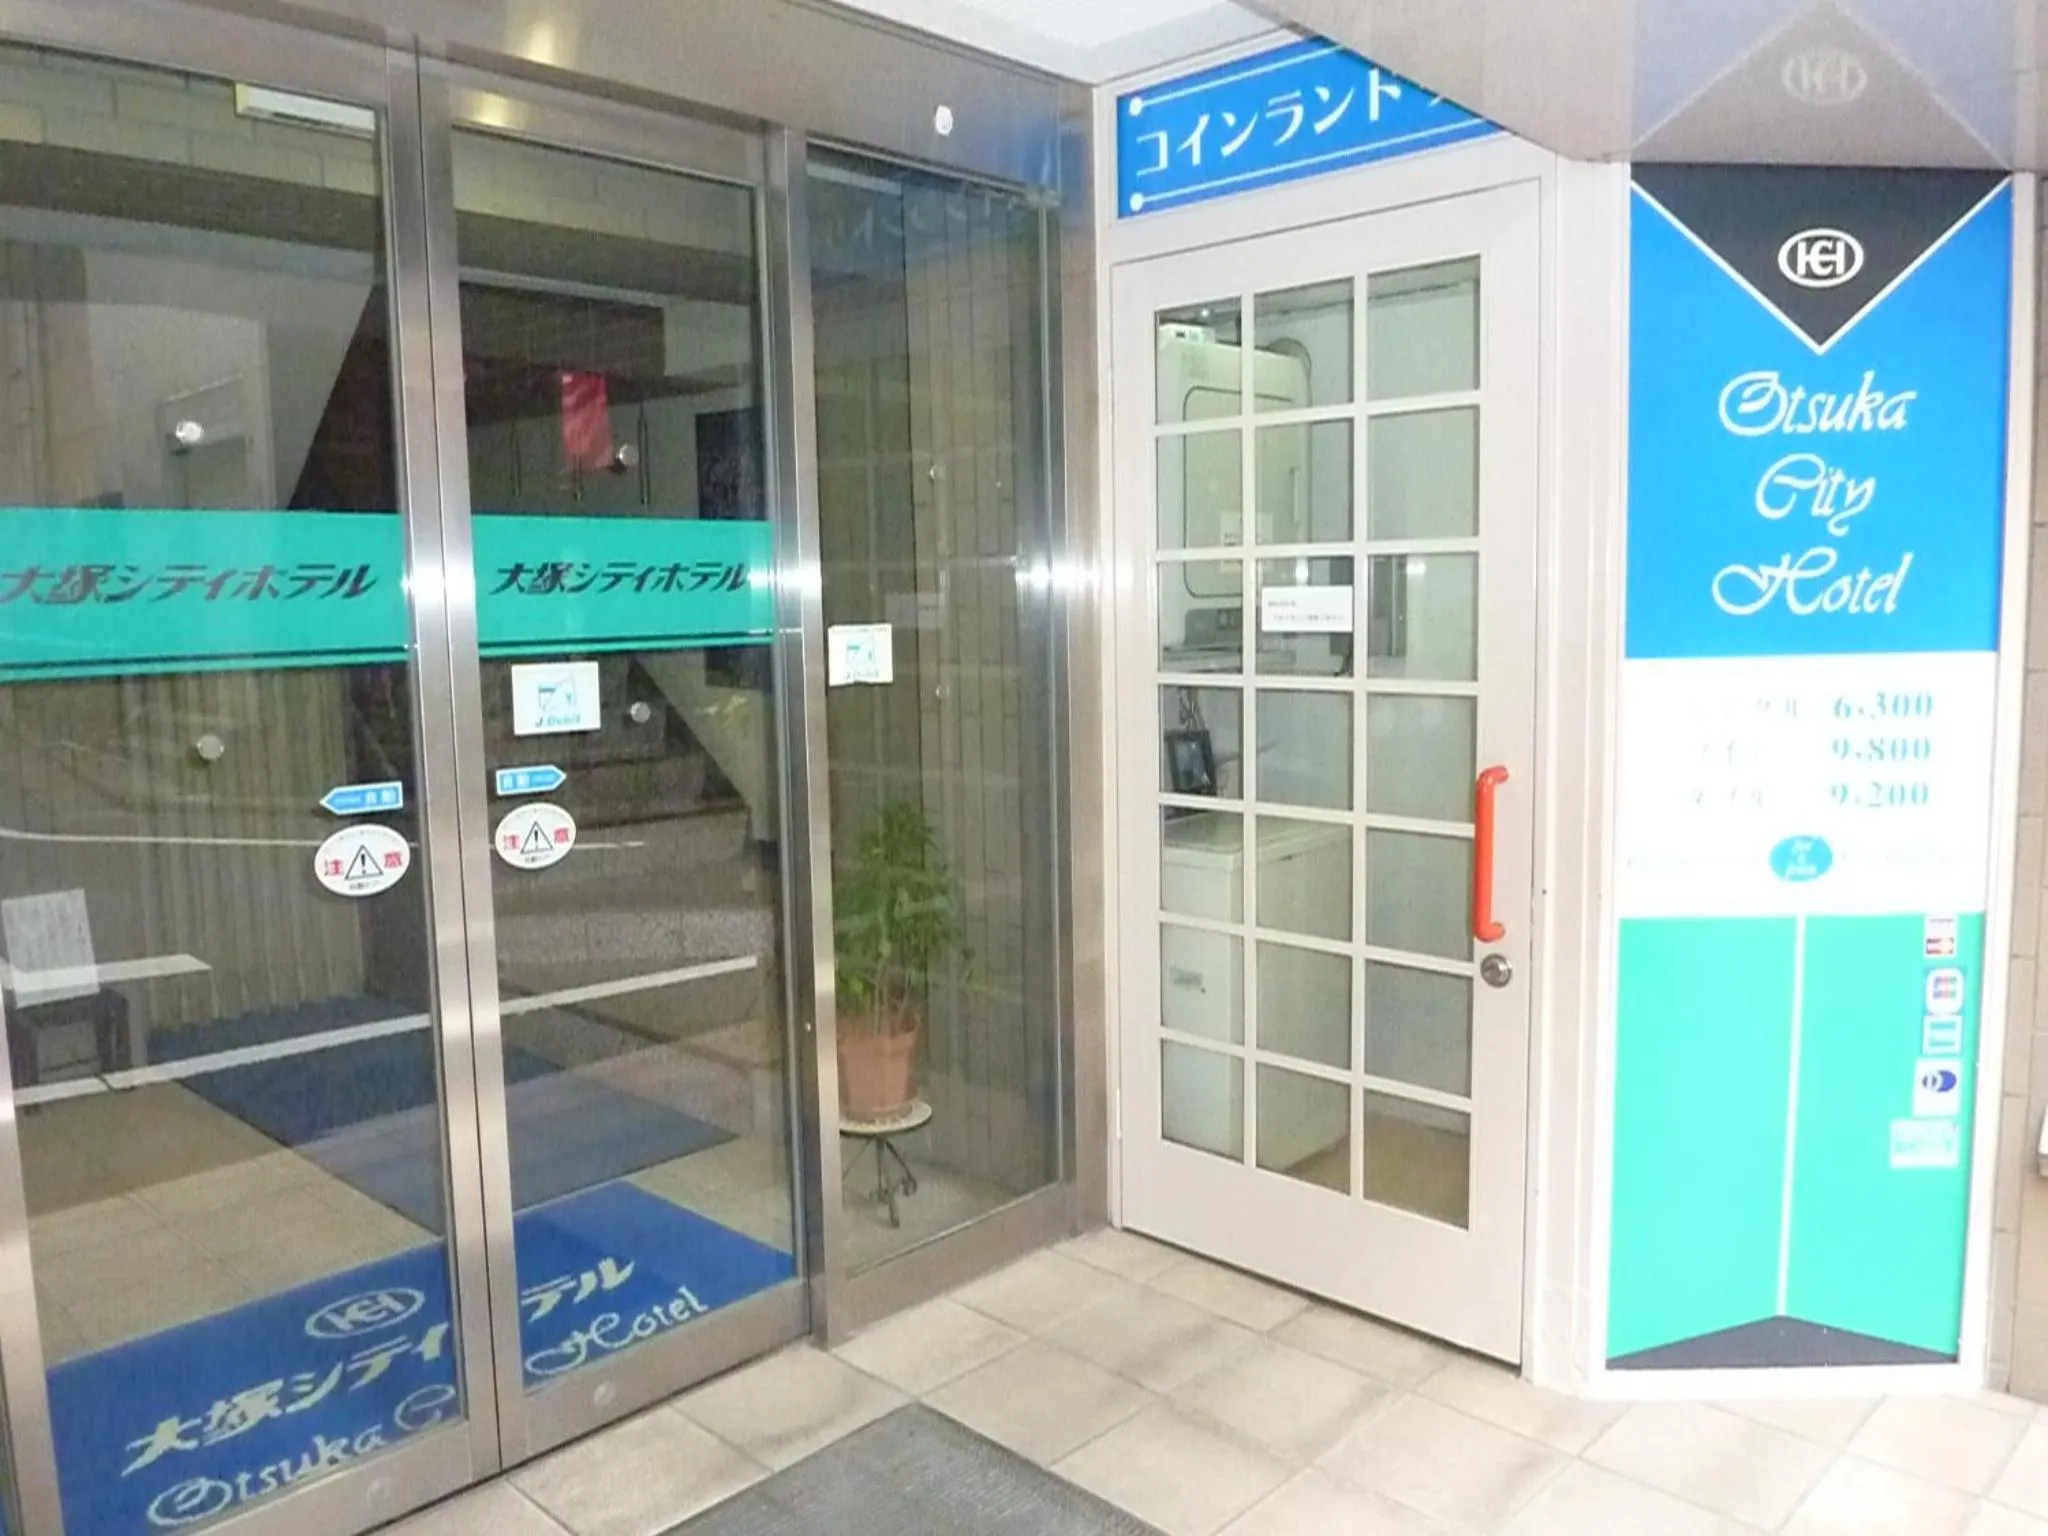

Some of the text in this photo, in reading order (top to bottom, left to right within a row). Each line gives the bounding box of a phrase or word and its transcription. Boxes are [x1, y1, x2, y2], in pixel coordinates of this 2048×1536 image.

[1718, 370, 1916, 437] Otsuka
[1755, 453, 1876, 537] City
[1, 563, 378, 606] 大塚シティホテル
[488, 561, 748, 596] 大塚シティホテル
[1712, 546, 1914, 616] Hotel
[146, 1284, 710, 1527] Otsuka Hotel
